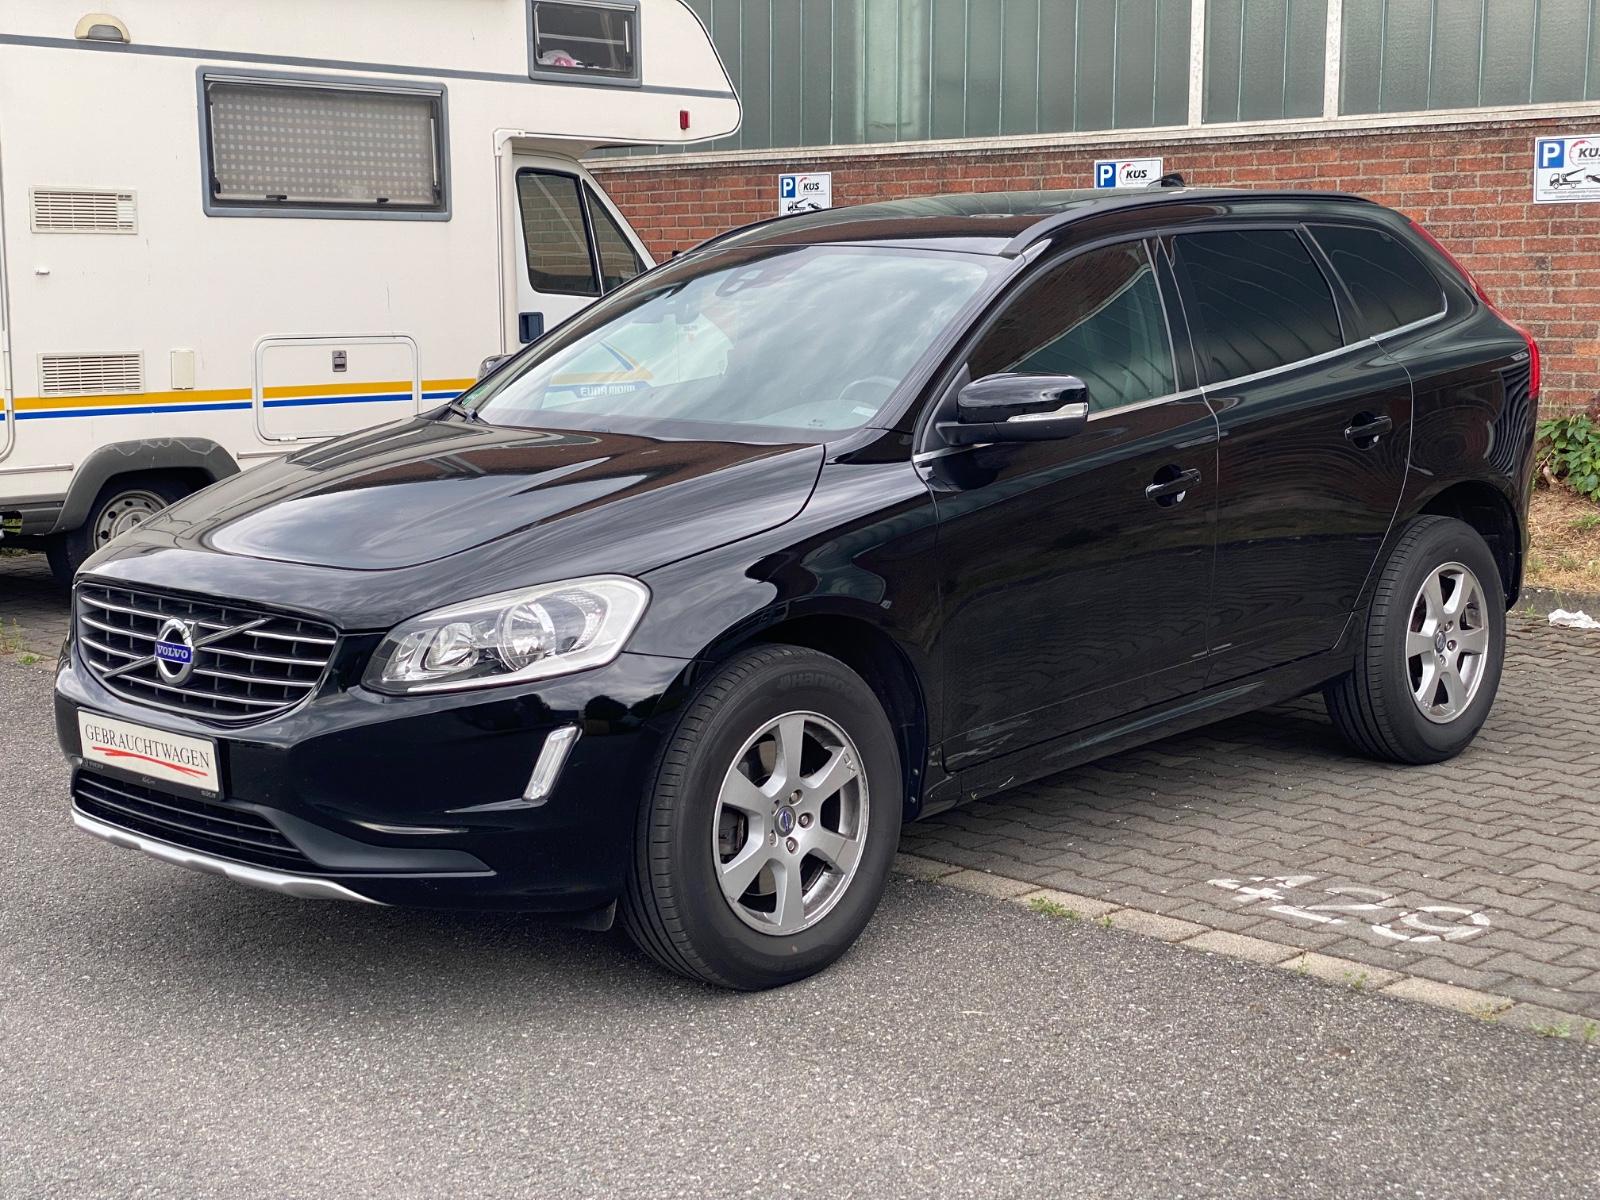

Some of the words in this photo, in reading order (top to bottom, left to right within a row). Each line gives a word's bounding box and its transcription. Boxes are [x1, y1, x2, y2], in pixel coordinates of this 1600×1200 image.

[1543, 143, 1561, 167] P
[1578, 147, 1600, 158] KÜ
[1100, 165, 1114, 186] P
[783, 178, 793, 197] P
[156, 644, 189, 659] VOLVO
[85, 723, 210, 769] GEBRAUCHTWAGEN
